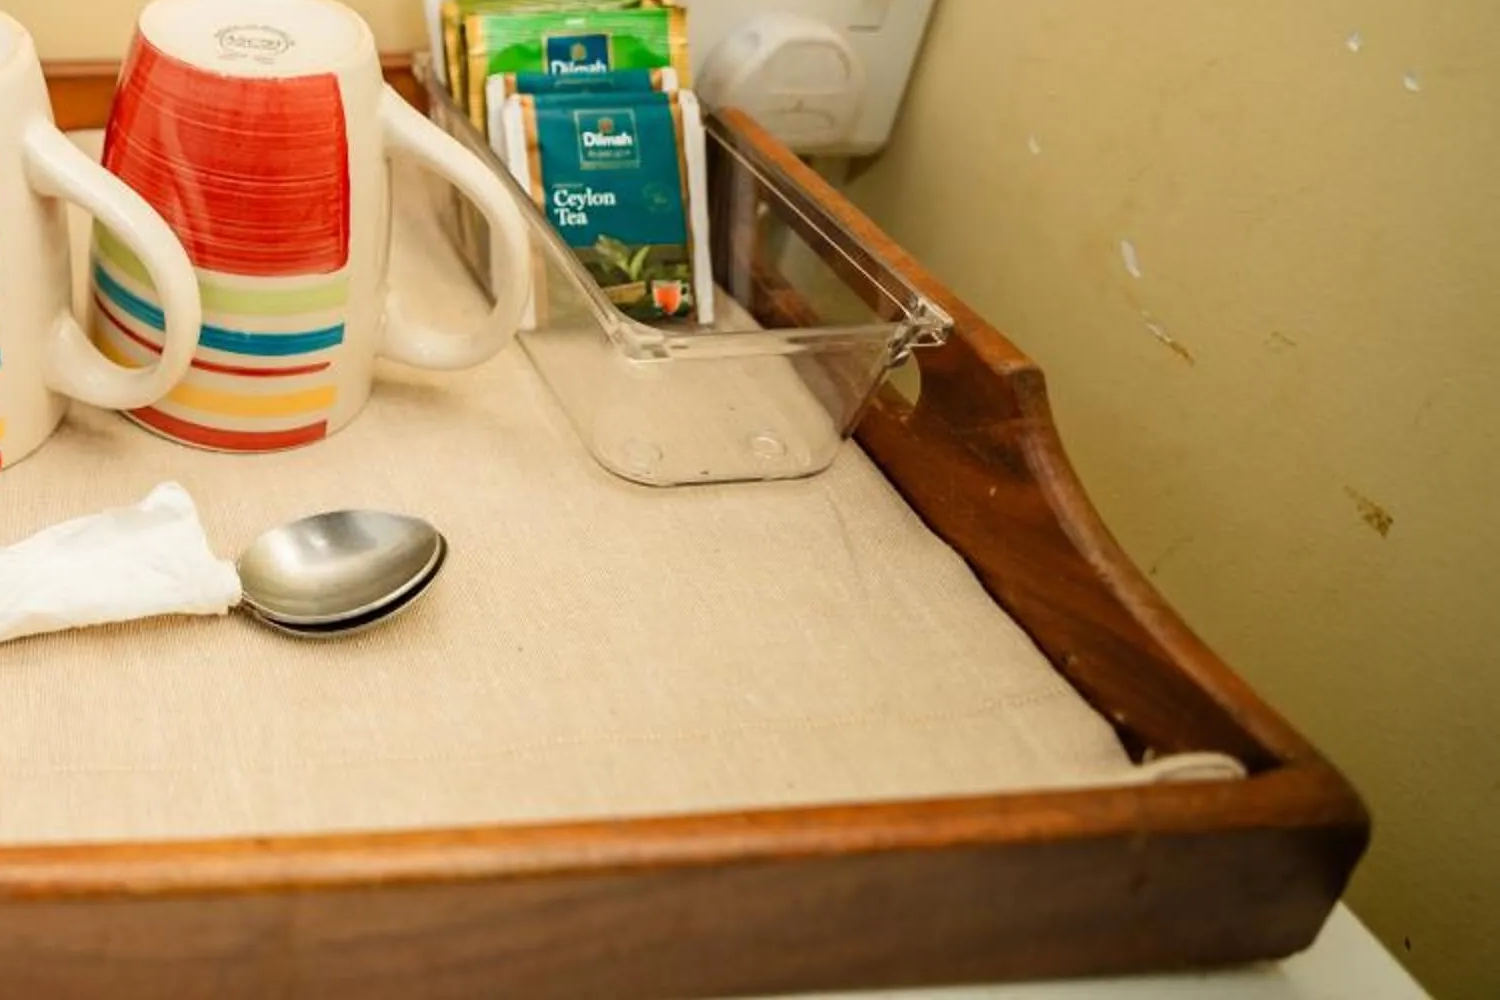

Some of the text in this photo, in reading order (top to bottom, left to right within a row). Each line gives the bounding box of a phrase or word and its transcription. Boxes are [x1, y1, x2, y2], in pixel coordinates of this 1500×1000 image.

[582, 131, 633, 148] Dilmah
[553, 187, 616, 210] Ceylon
[553, 207, 588, 226] Tea
